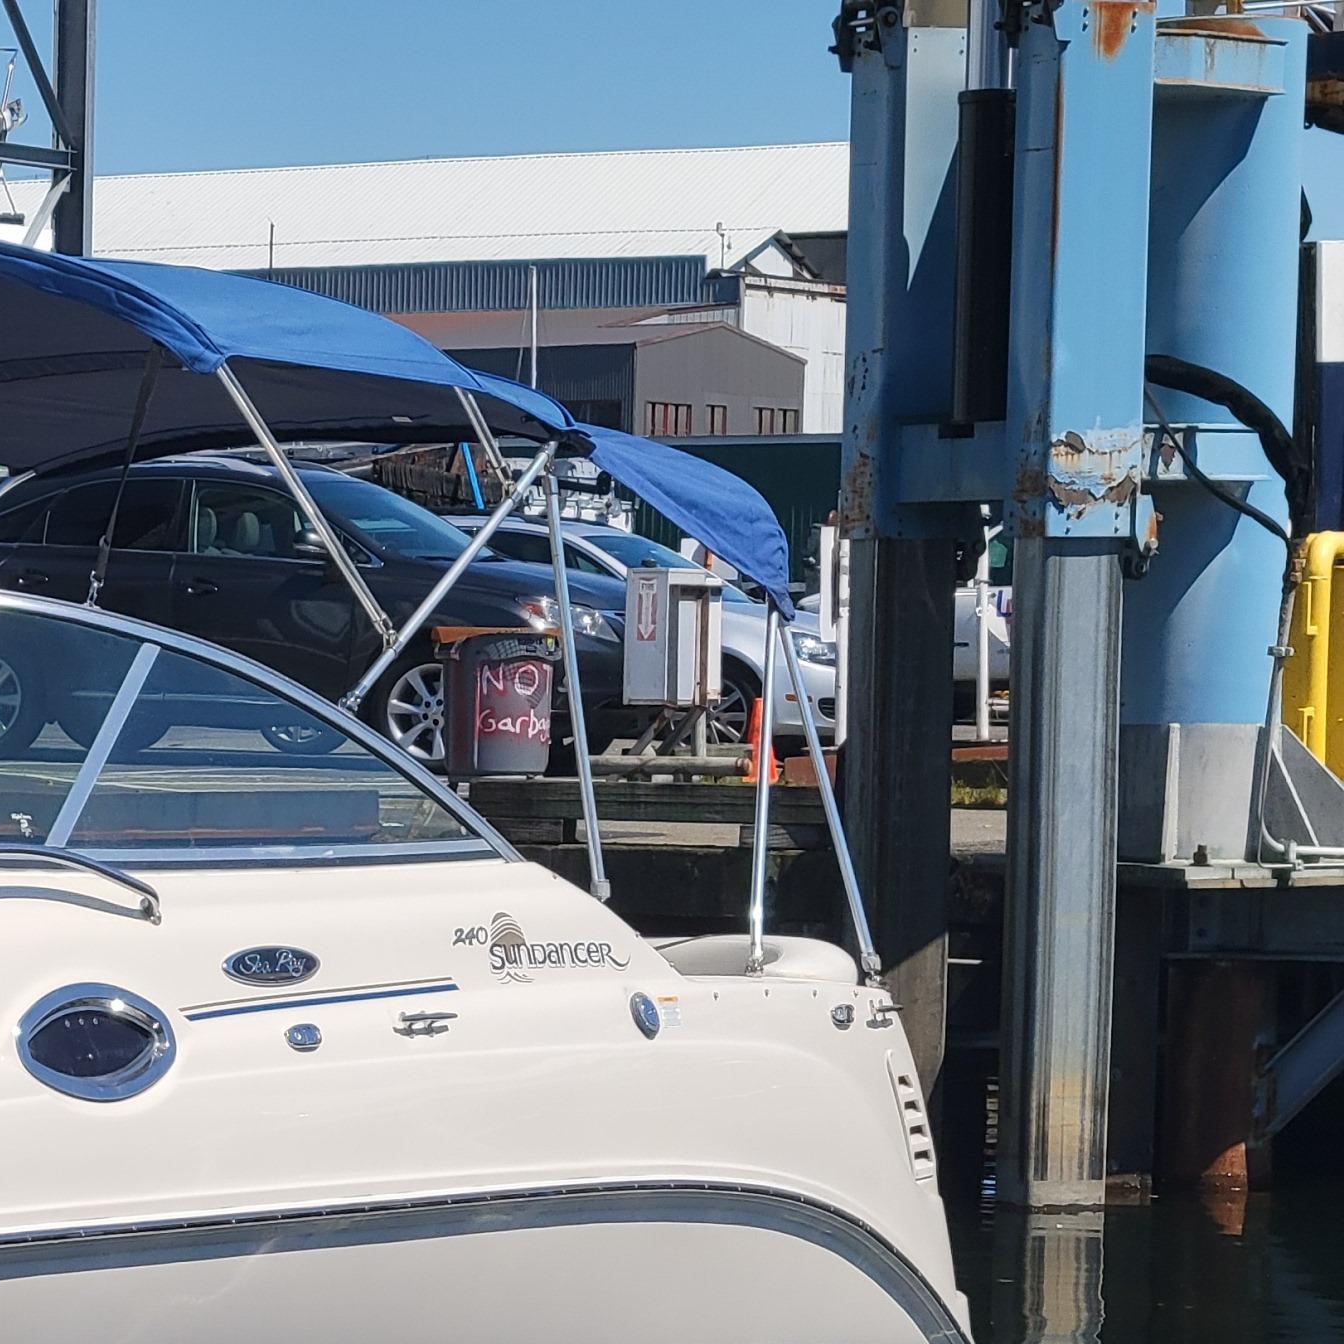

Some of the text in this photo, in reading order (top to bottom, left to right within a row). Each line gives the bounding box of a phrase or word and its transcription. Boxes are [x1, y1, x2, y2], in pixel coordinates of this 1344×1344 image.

[452, 926, 489, 947] 240
[239, 949, 307, 977] Sea Ray
